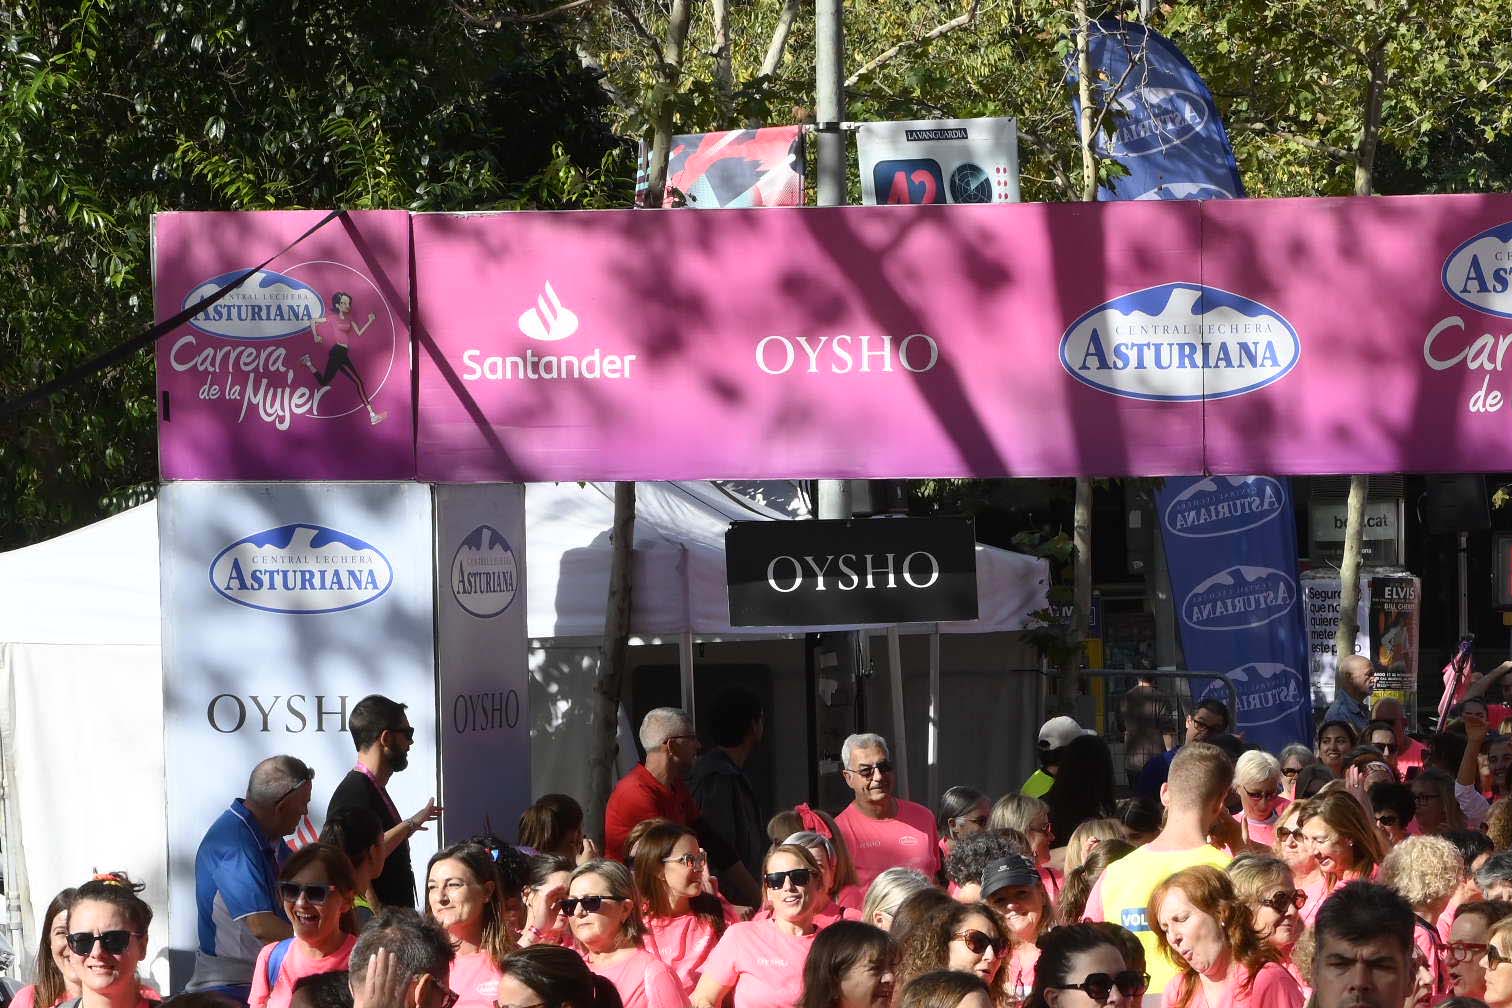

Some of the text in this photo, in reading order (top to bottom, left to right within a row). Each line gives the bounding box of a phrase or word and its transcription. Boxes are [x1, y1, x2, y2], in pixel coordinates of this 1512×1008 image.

[916, 130, 967, 139] VANGUARDIA
[194, 294, 314, 322] ASTURIANA
[1115, 323, 1193, 336] CENTRAL
[170, 337, 287, 372] Carrera
[462, 350, 636, 380] Santander
[755, 334, 938, 375] OYSHO
[1079, 329, 1281, 370] ASTURIANA
[199, 370, 332, 430] de la Mujer
[1468, 375, 1505, 414] de
[225, 557, 380, 591] ASTURIANA
[252, 555, 374, 565] CENTRAL LECHERA
[456, 560, 515, 595] ASTURIANA
[767, 551, 940, 593] OYSHO
[1384, 587, 1414, 599] ELVIS
[207, 693, 350, 734] OYSH
[453, 688, 520, 734] OYSHO
